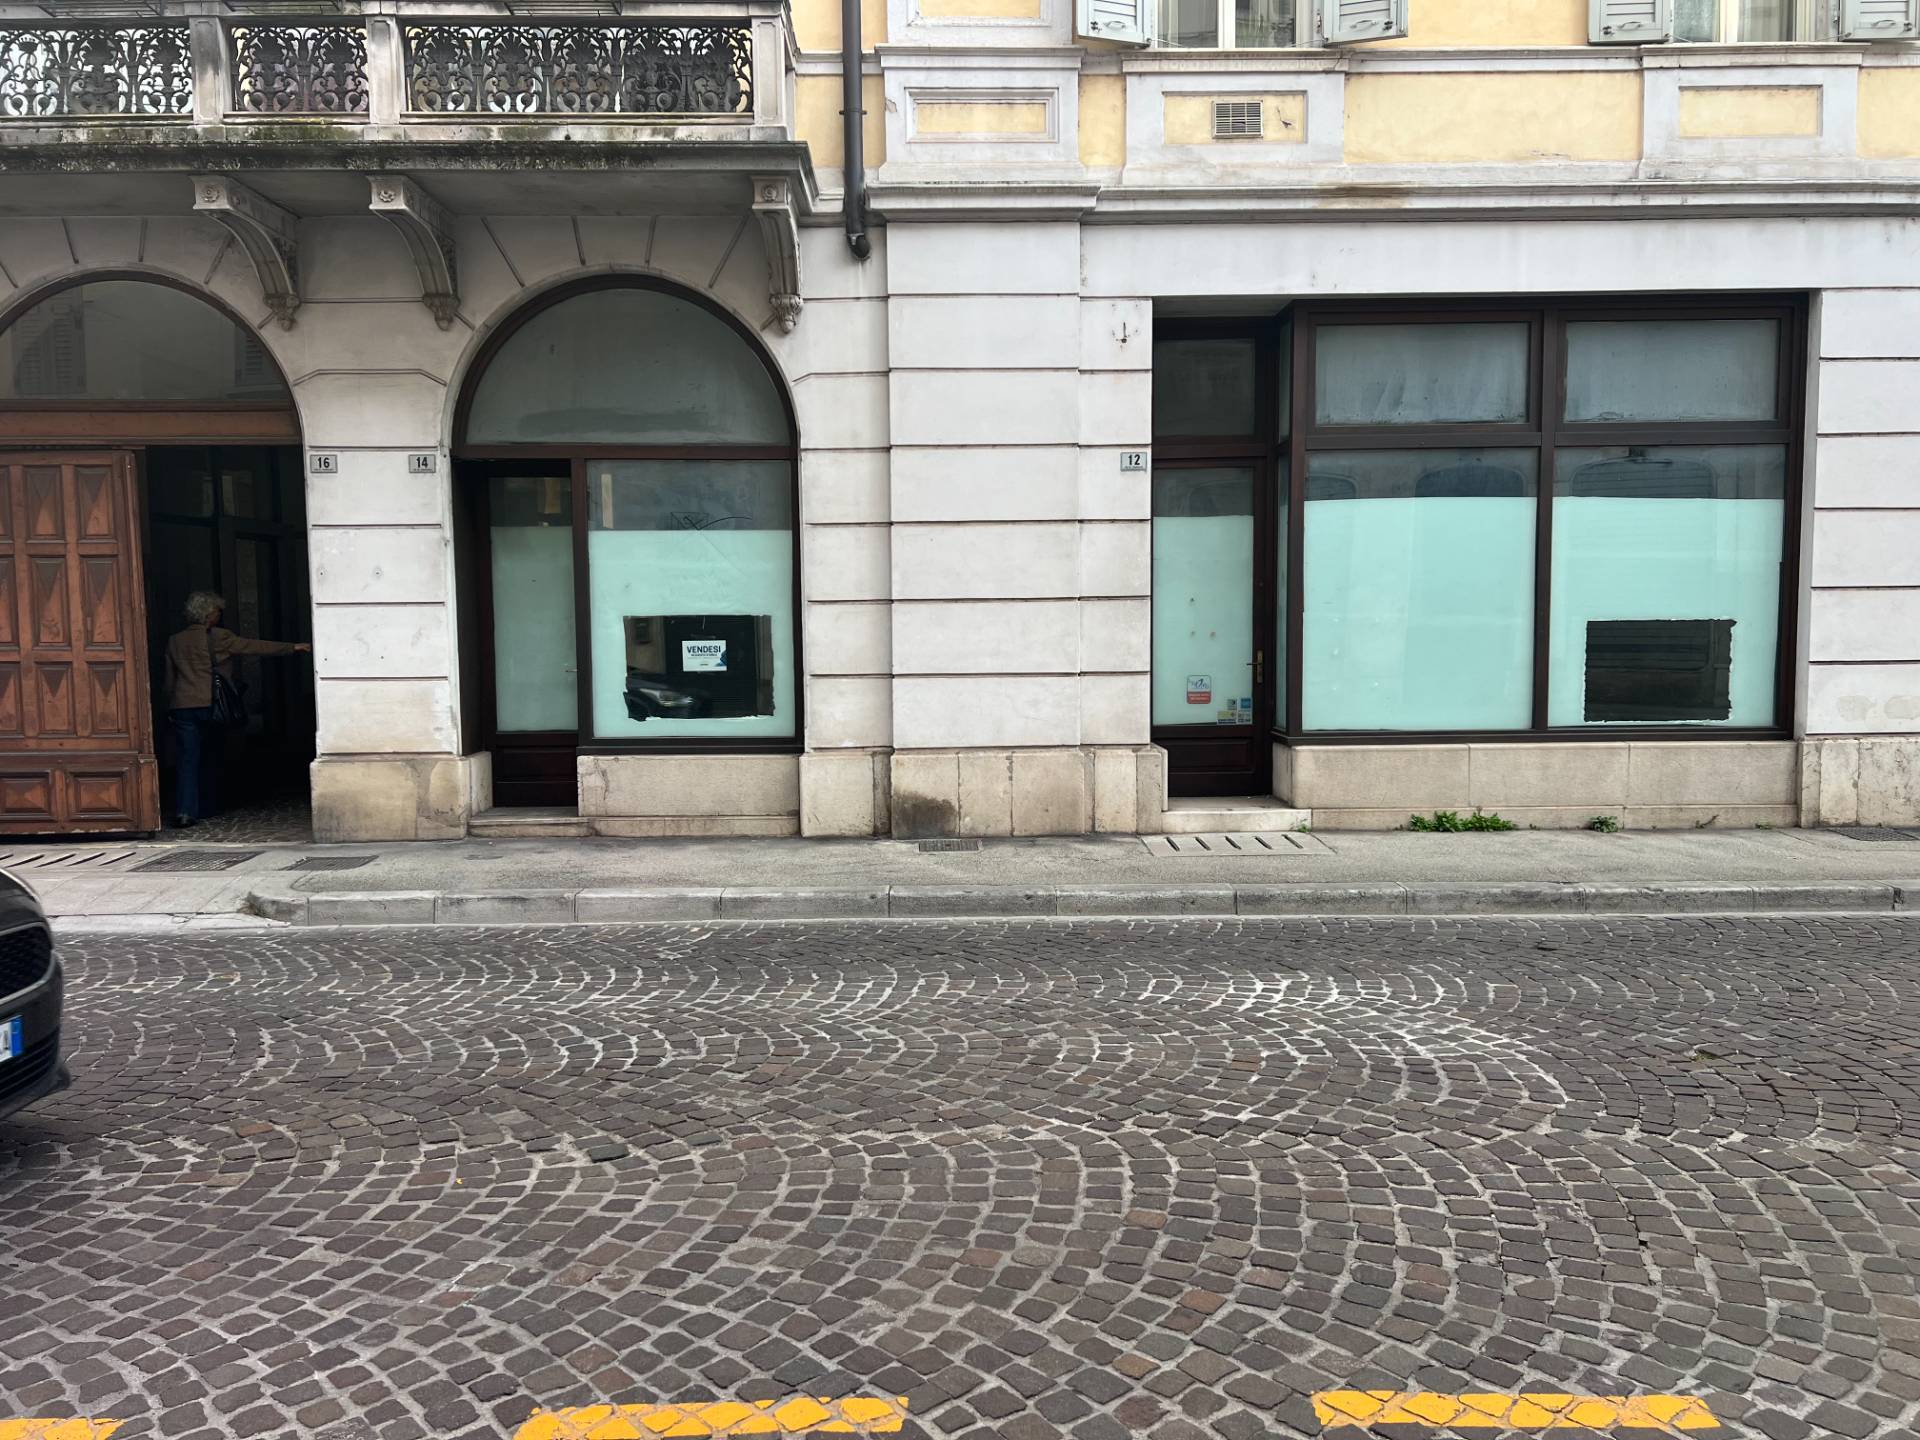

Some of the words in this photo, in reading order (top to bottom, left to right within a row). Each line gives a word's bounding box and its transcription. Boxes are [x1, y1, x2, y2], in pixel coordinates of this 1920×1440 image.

[317, 456, 330, 468] 16
[416, 456, 429, 468] 14
[1128, 454, 1141, 465] 12
[687, 645, 721, 653] VENDESI
